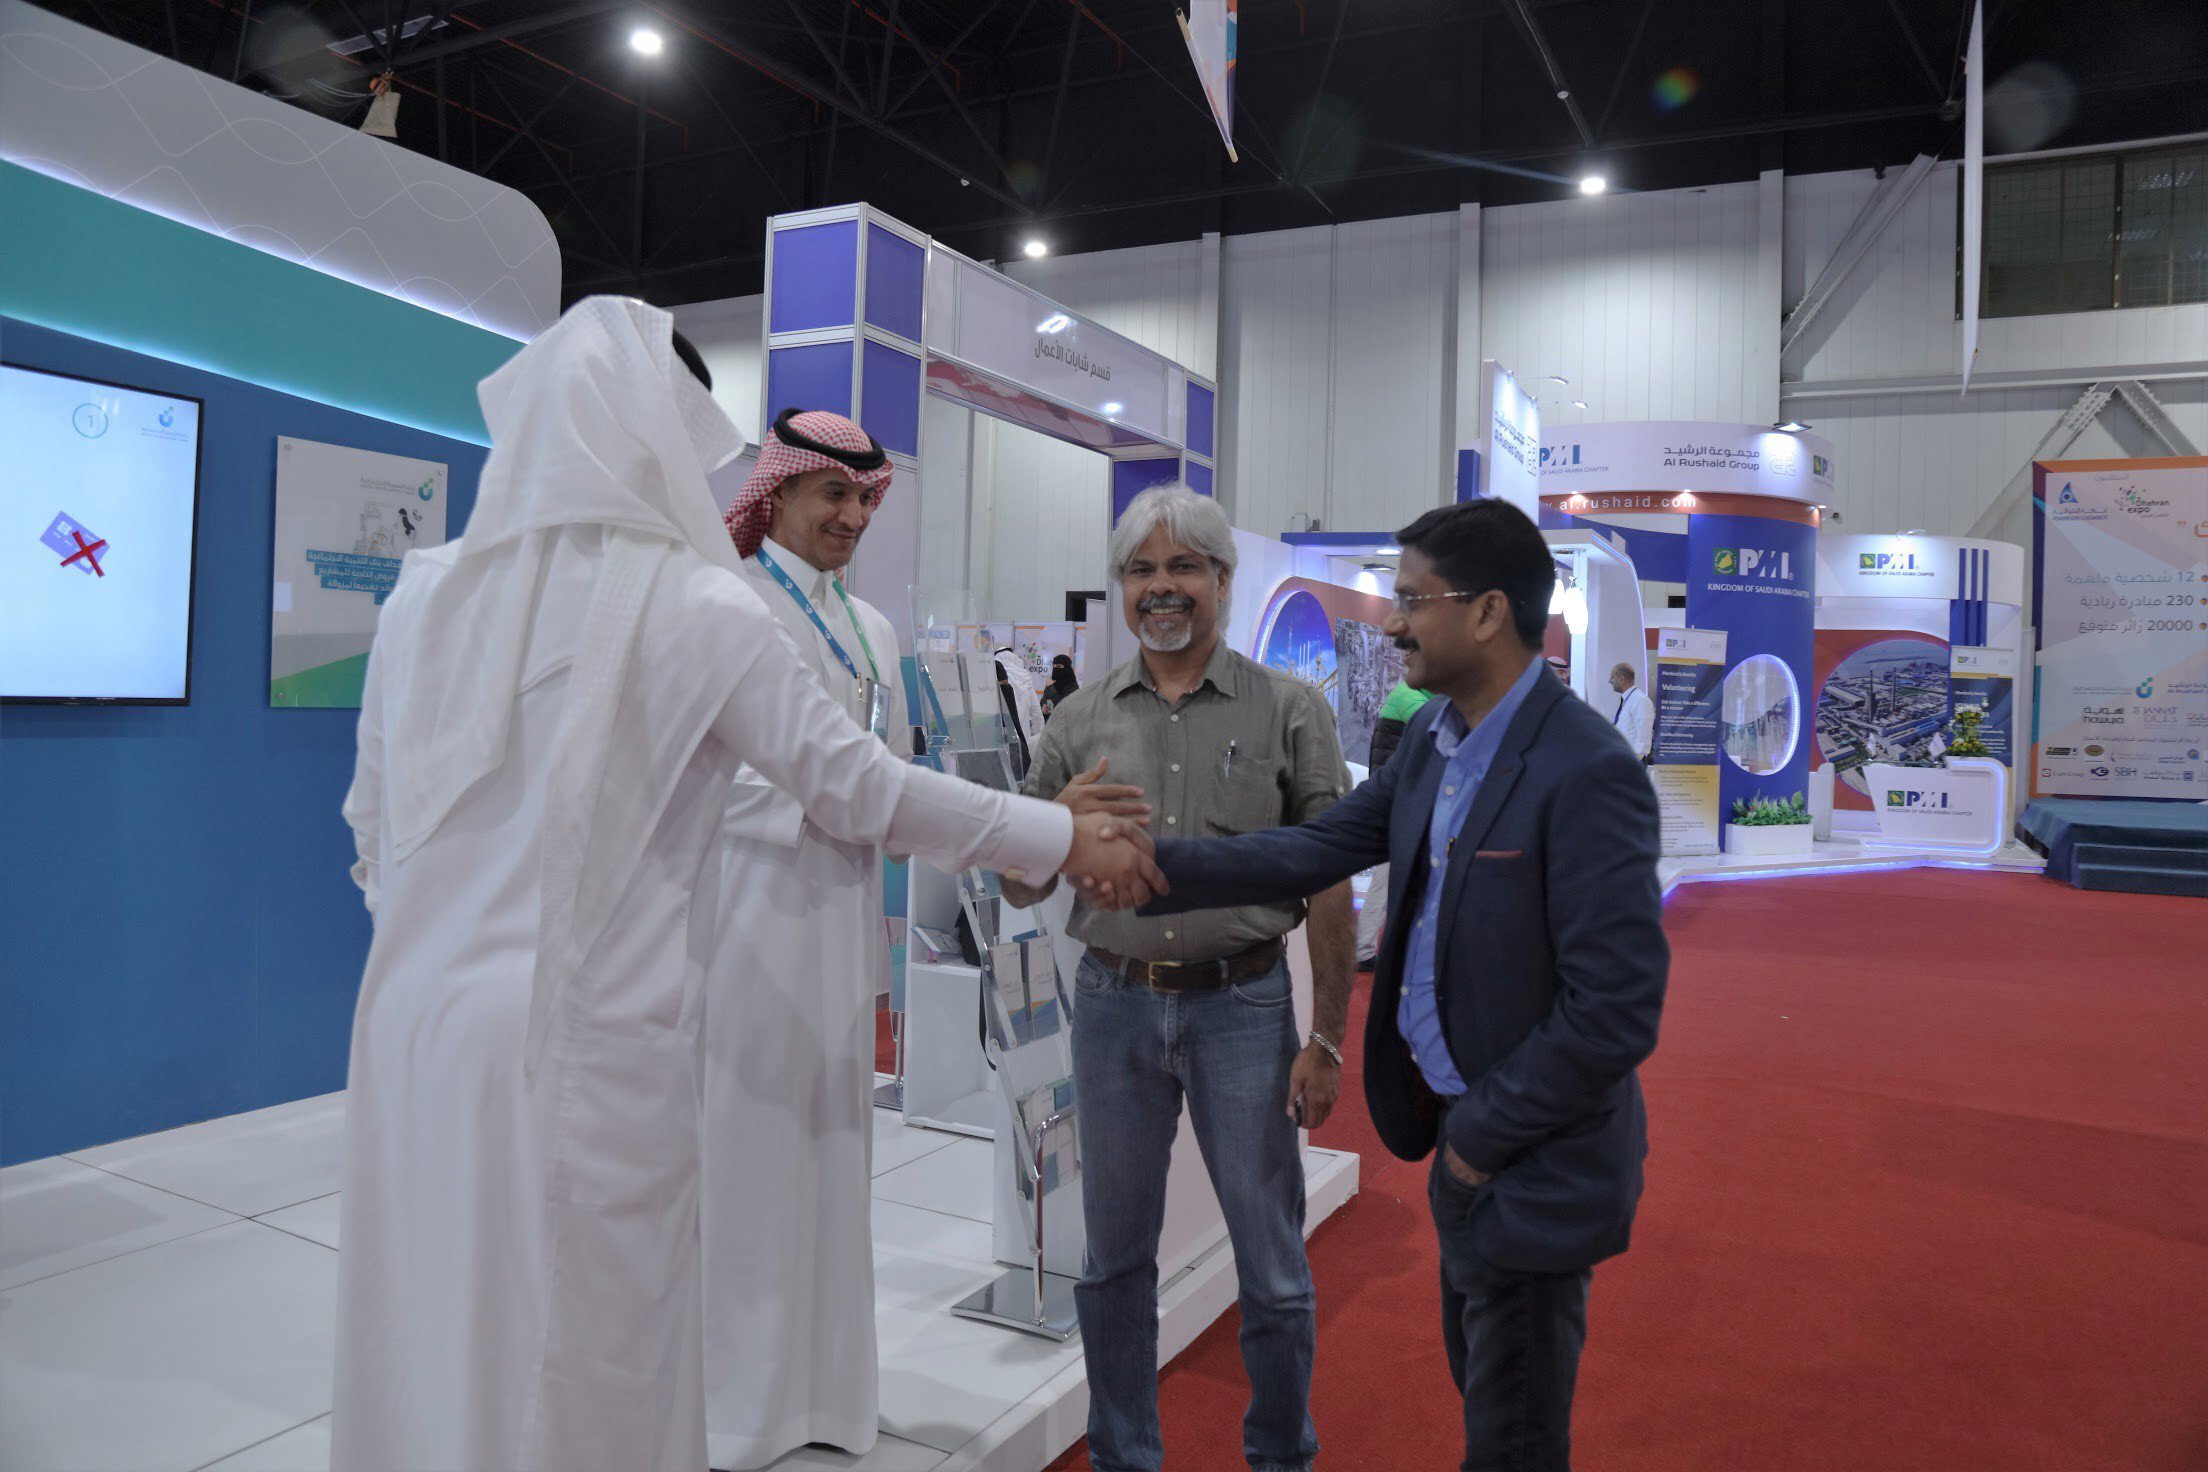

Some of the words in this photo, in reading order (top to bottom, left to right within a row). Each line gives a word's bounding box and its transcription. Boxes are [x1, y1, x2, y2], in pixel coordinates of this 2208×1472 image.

[1034, 337, 1064, 362] الأعمال
[1065, 348, 1089, 372] شابات
[1090, 364, 1111, 381] قسم
[1663, 443, 1707, 456] الرشيد
[1709, 445, 1760, 458] مجموعة
[1663, 458, 1676, 467] Al
[1678, 458, 1726, 469] Rushaid
[1729, 460, 1760, 471] Group
[2127, 506, 2151, 514] expo
[1739, 548, 1790, 580] PMI
[1877, 553, 1914, 570] PMI
[2065, 573, 2111, 584] ملهمة
[2116, 571, 2172, 585] شخصية
[2178, 571, 2194, 582] 12
[1707, 583, 1744, 592] KINGDOM
[1745, 585, 1755, 593] OF
[1755, 585, 1773, 594] SAUDI
[2081, 596, 2116, 609] ريادية
[2120, 595, 2162, 609] مبادرة
[2166, 595, 2194, 606] 230
[2078, 620, 2117, 634] متوقع
[2147, 620, 2193, 631] 20000
[1029, 666, 1048, 674] expo
[1661, 683, 1696, 693] Volunteering
[1906, 790, 1948, 808] PMI
